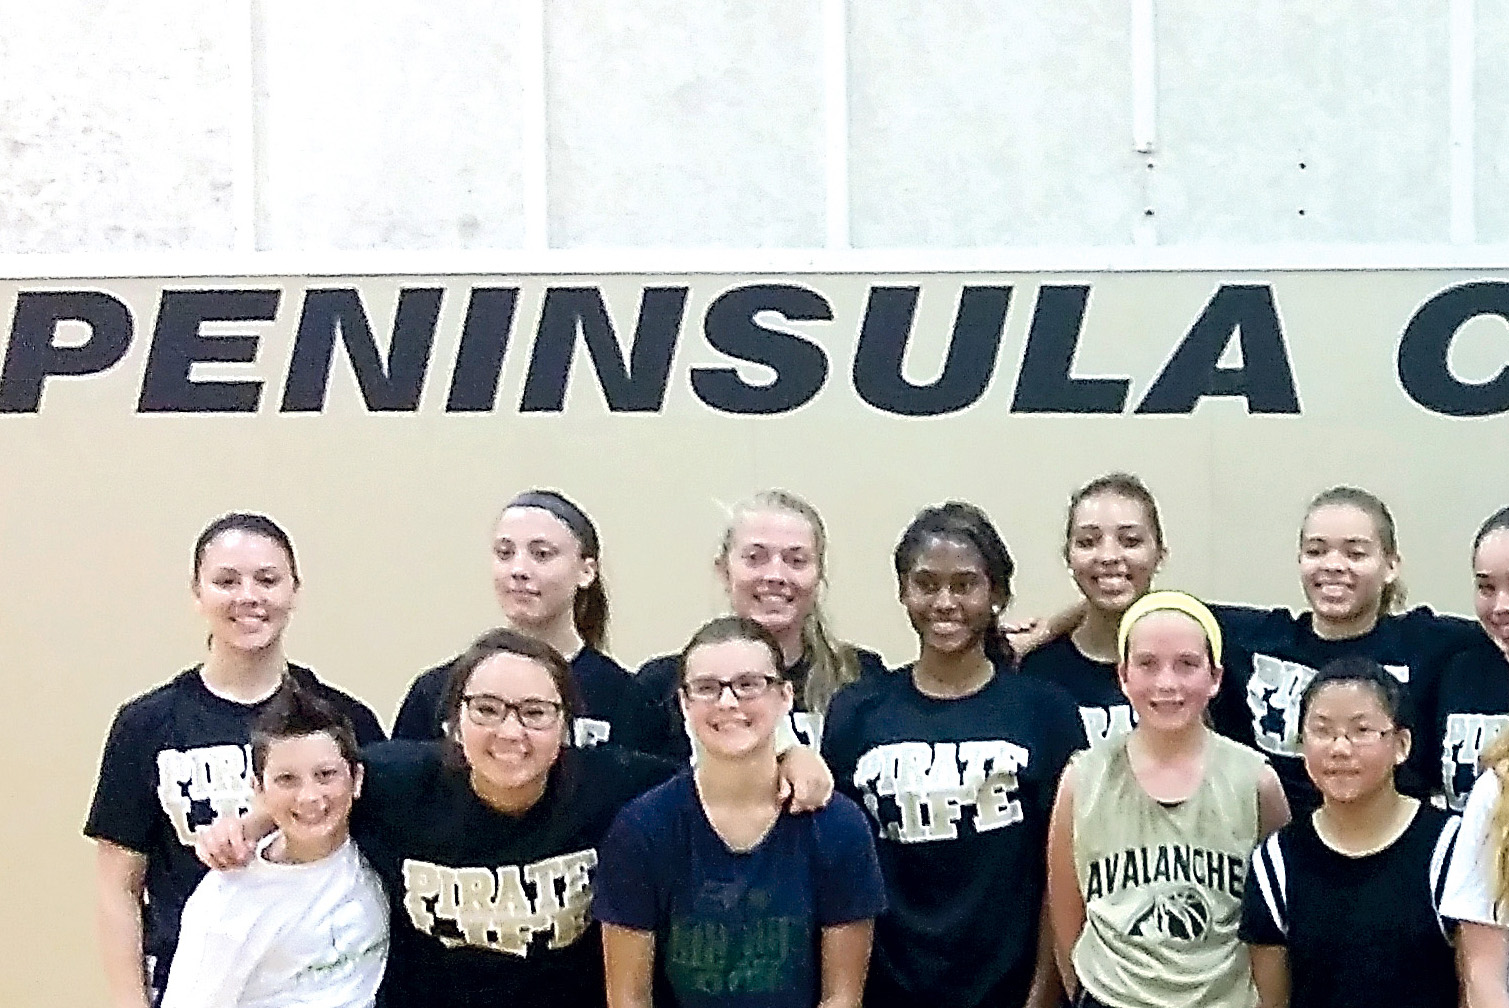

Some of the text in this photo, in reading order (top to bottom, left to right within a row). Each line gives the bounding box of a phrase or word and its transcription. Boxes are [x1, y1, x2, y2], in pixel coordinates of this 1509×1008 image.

[0, 283, 1302, 416] PENINSULA
[853, 740, 1029, 796] PIRATE
[402, 848, 598, 918] PIRATE
[1087, 844, 1244, 901] AVALANCHE
